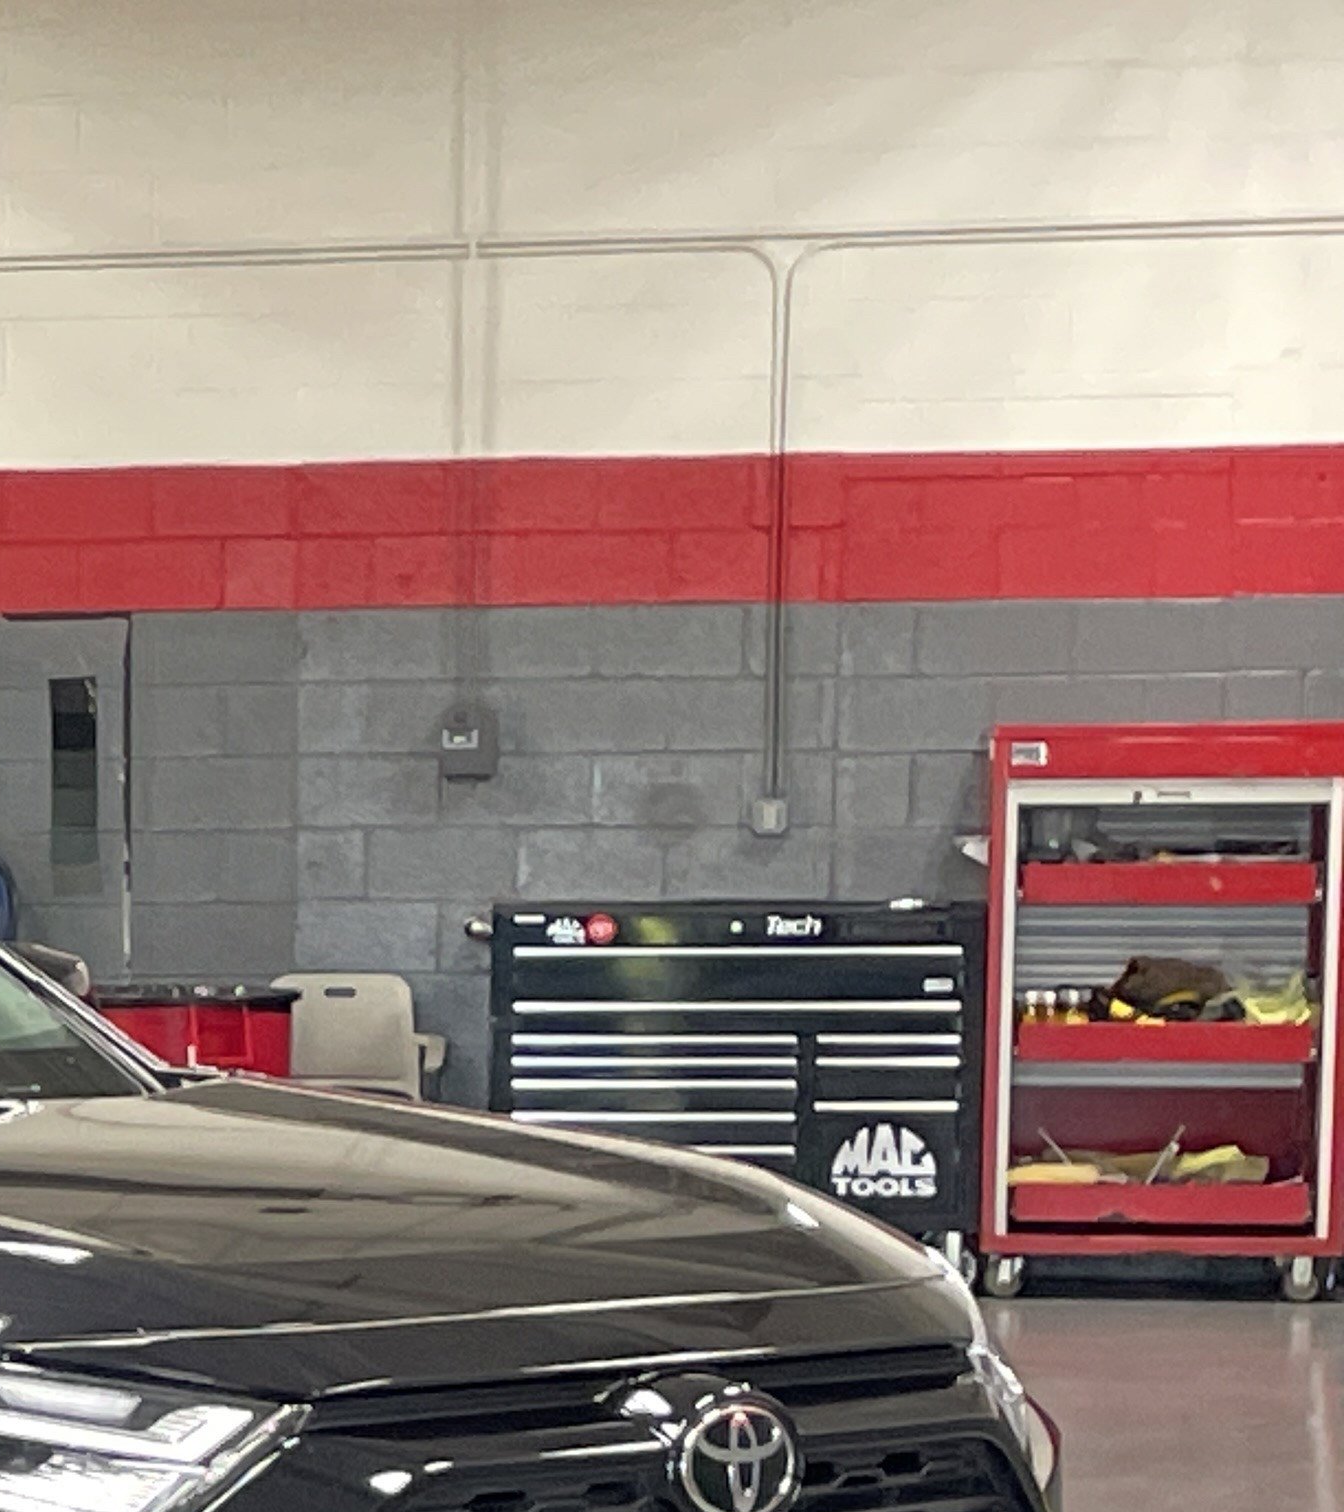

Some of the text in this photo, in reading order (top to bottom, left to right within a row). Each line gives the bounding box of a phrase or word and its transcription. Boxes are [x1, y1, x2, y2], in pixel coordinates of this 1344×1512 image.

[767, 914, 822, 936] Tech
[831, 1122, 937, 1176] MAC
[831, 1176, 938, 1198] TOOLS
